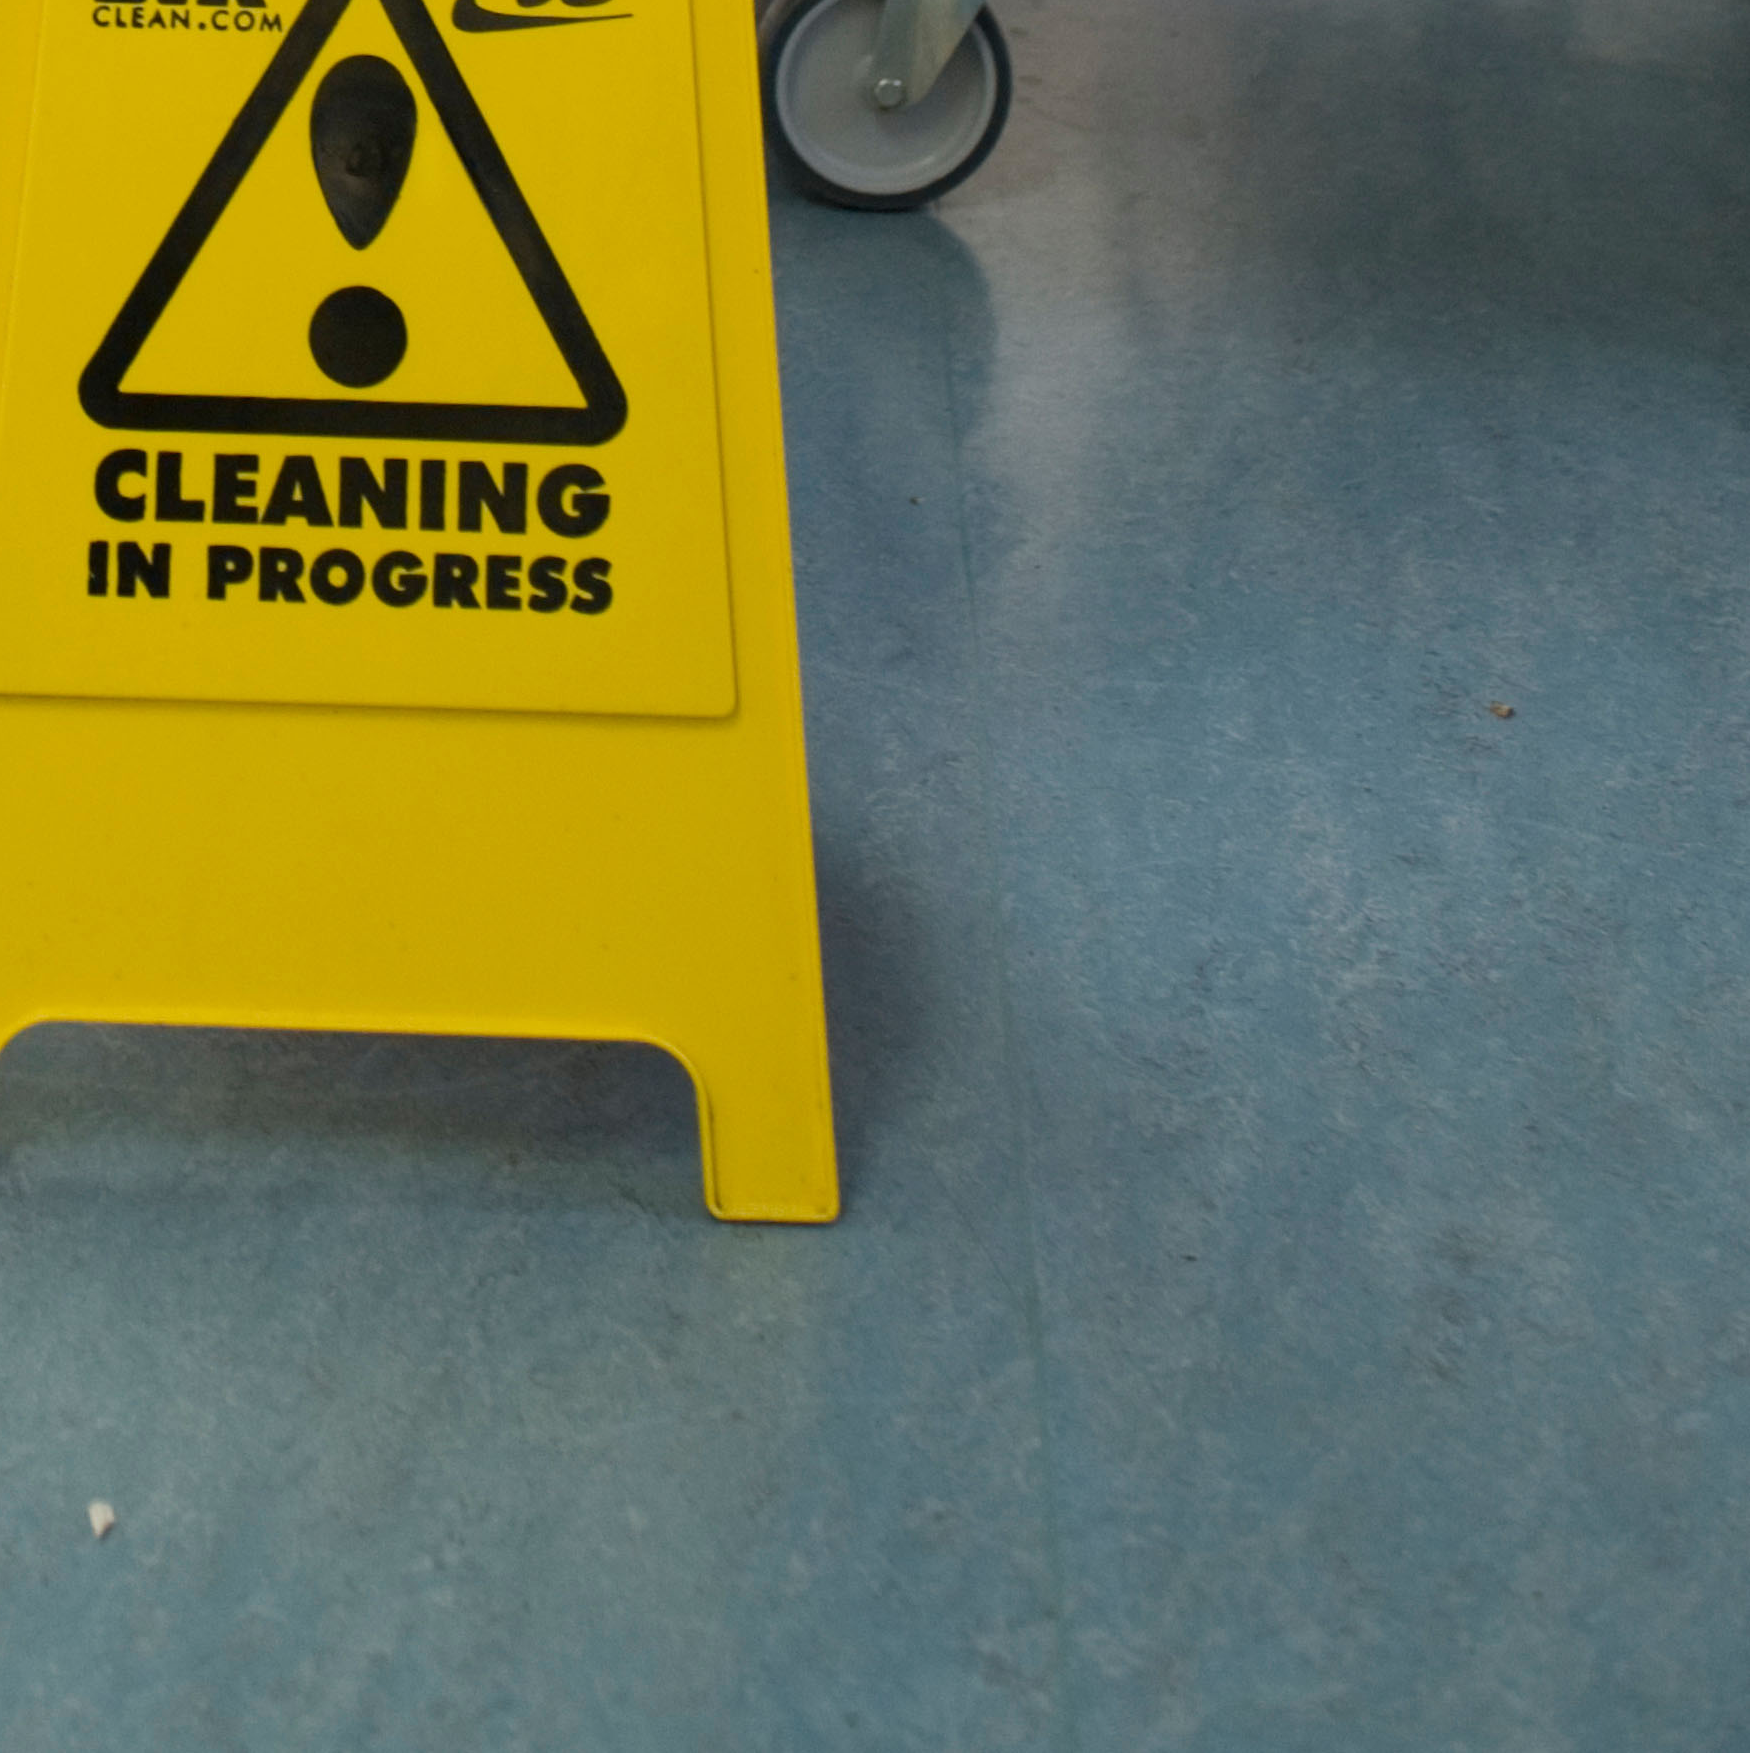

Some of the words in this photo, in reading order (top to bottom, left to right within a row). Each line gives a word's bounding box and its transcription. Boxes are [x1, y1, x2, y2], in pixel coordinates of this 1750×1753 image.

[91, 4, 283, 33] CLEAN.COM
[93, 447, 612, 540] CLEANING
[86, 540, 172, 599] IN
[205, 543, 614, 616] PROGRESS
